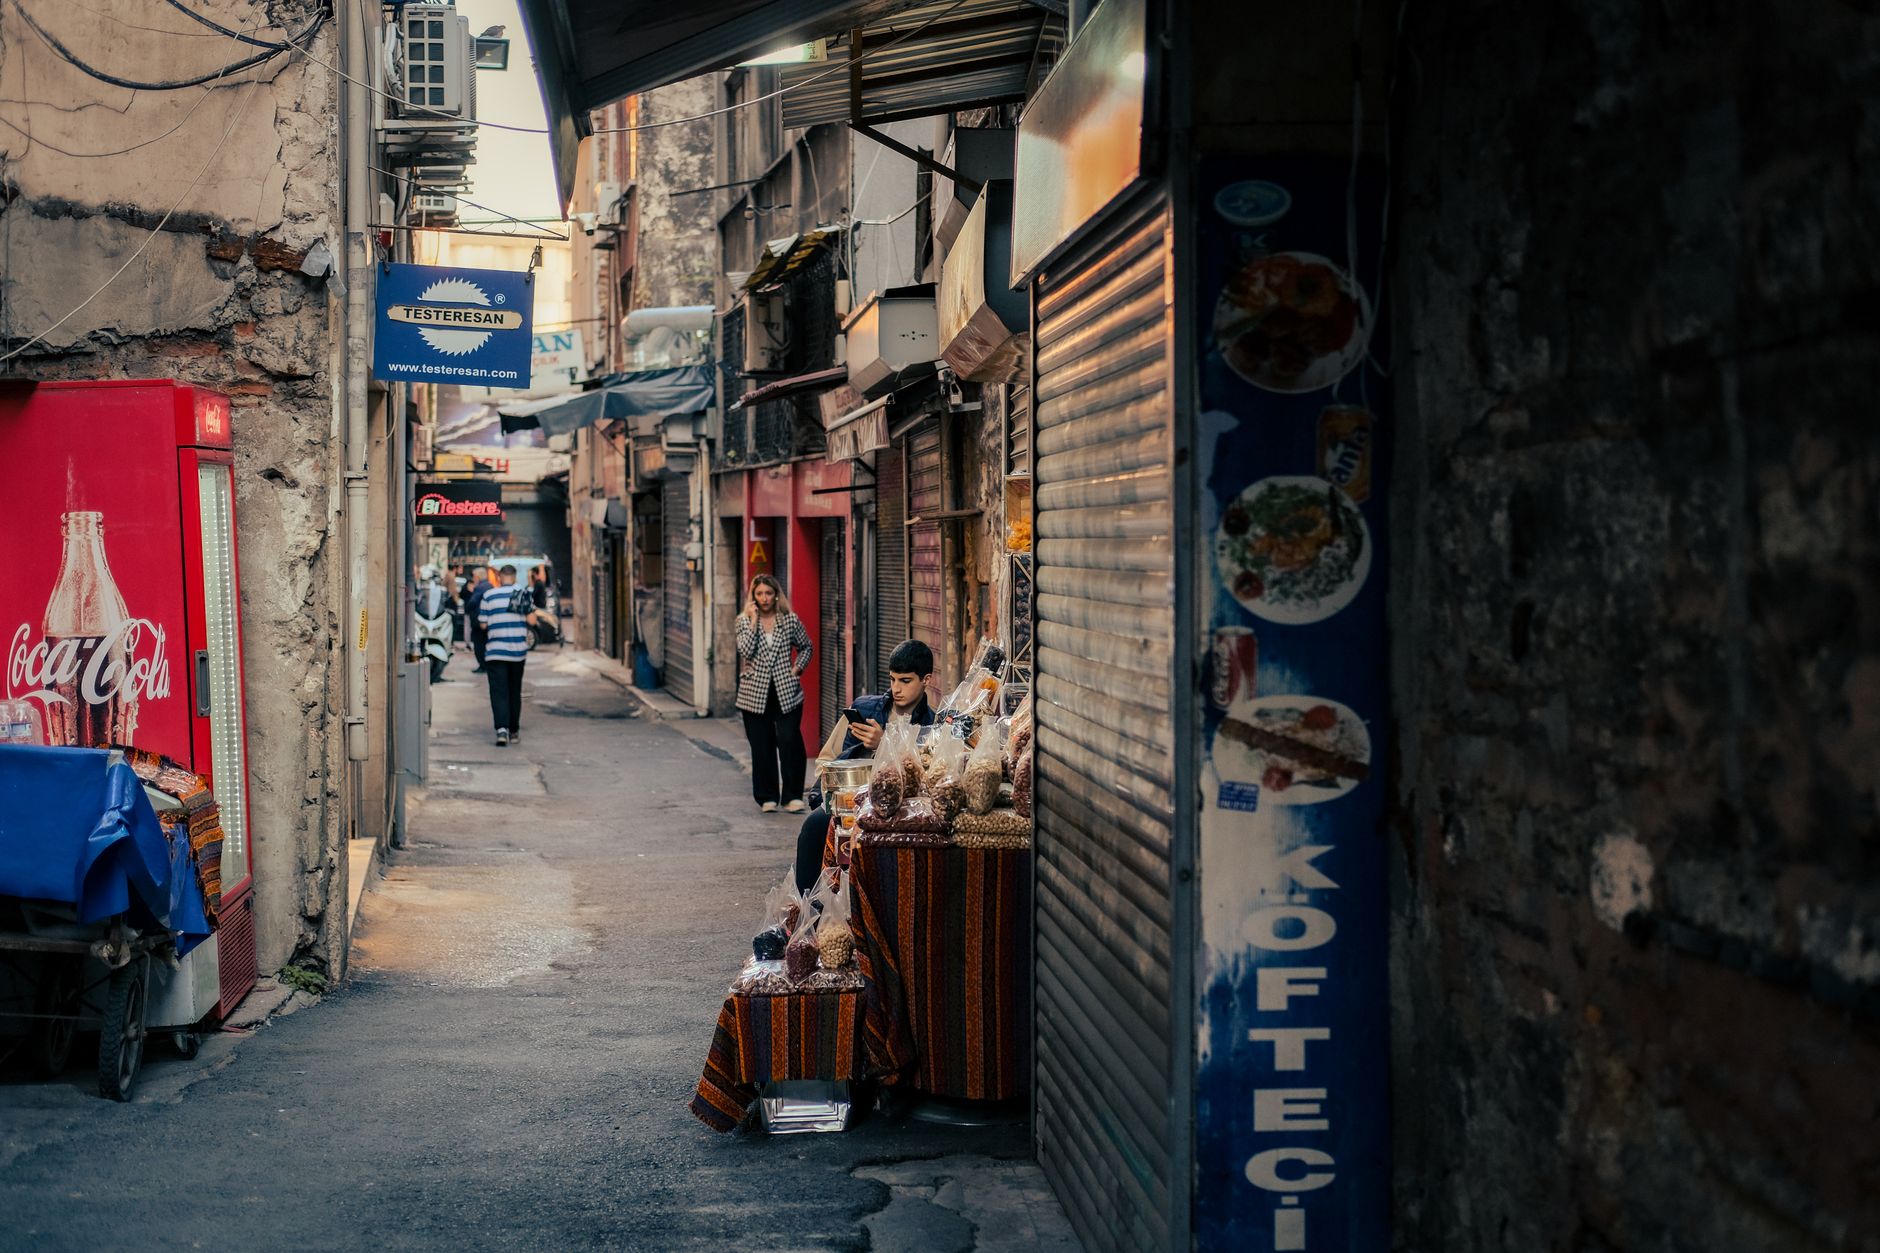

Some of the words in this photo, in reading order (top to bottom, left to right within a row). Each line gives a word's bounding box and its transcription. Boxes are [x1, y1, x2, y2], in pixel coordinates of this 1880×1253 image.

[403, 308, 504, 324] TESTERESAN
[388, 363, 518, 379] www.testeresan.com
[7, 618, 170, 705] Coca-Cola
